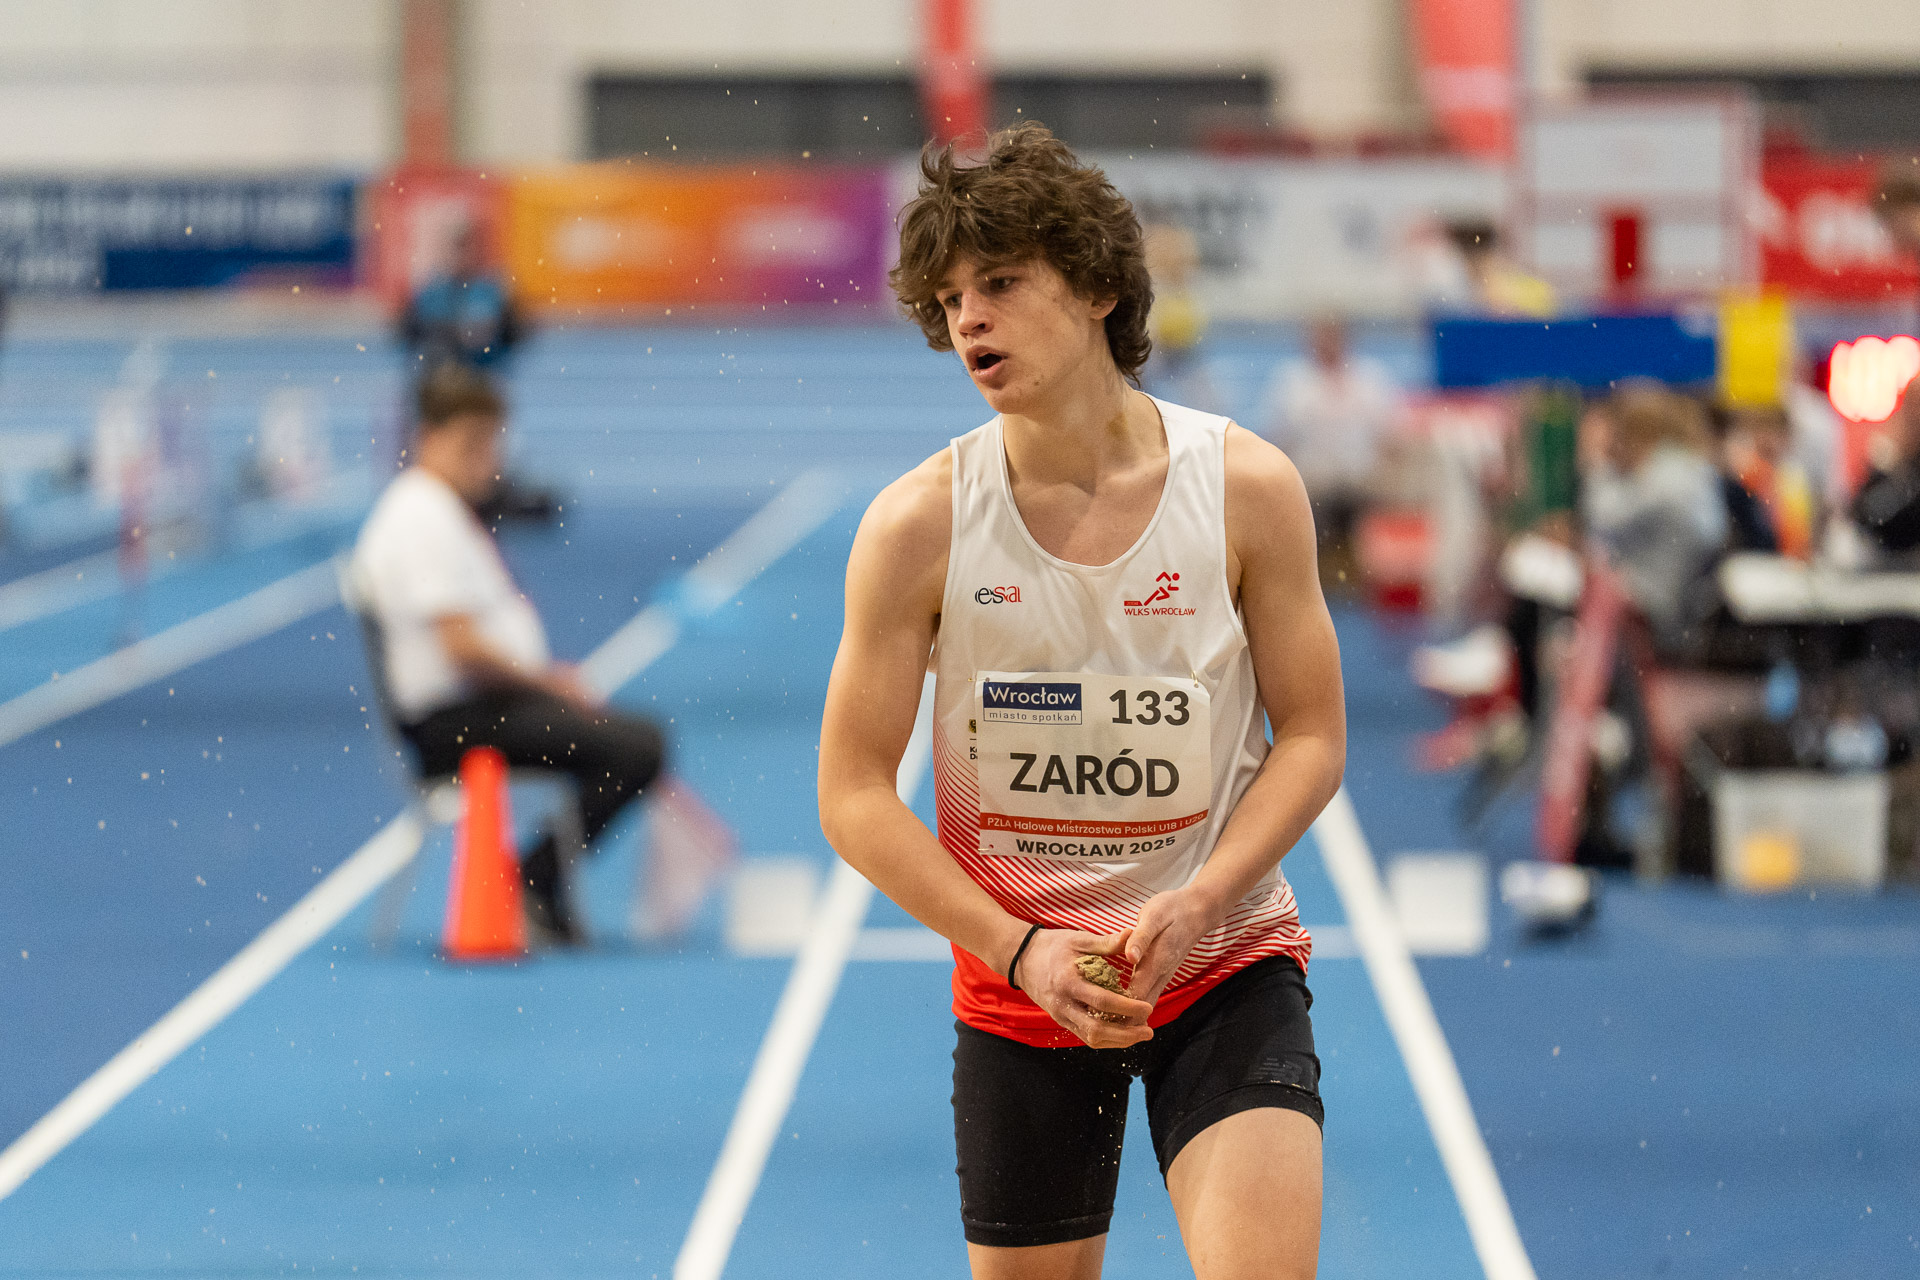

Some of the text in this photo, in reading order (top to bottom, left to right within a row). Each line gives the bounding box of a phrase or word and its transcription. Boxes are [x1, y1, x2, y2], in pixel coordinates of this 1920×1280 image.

[1124, 607, 1150, 616] WLKS
[988, 686, 1076, 705] Wrocław
[989, 710, 1077, 723] miasto spotkań
[1109, 689, 1190, 726] 133
[1009, 748, 1180, 798] ZARÓD
[987, 817, 1012, 828] PZLA
[1014, 820, 1054, 832] Halowe
[1056, 823, 1122, 835] Mistrzostwa
[1124, 824, 1156, 835] Polski
[1159, 821, 1177, 832] U18
[1185, 813, 1204, 825] U20
[1016, 835, 1176, 857] WROCŁAW 2025
